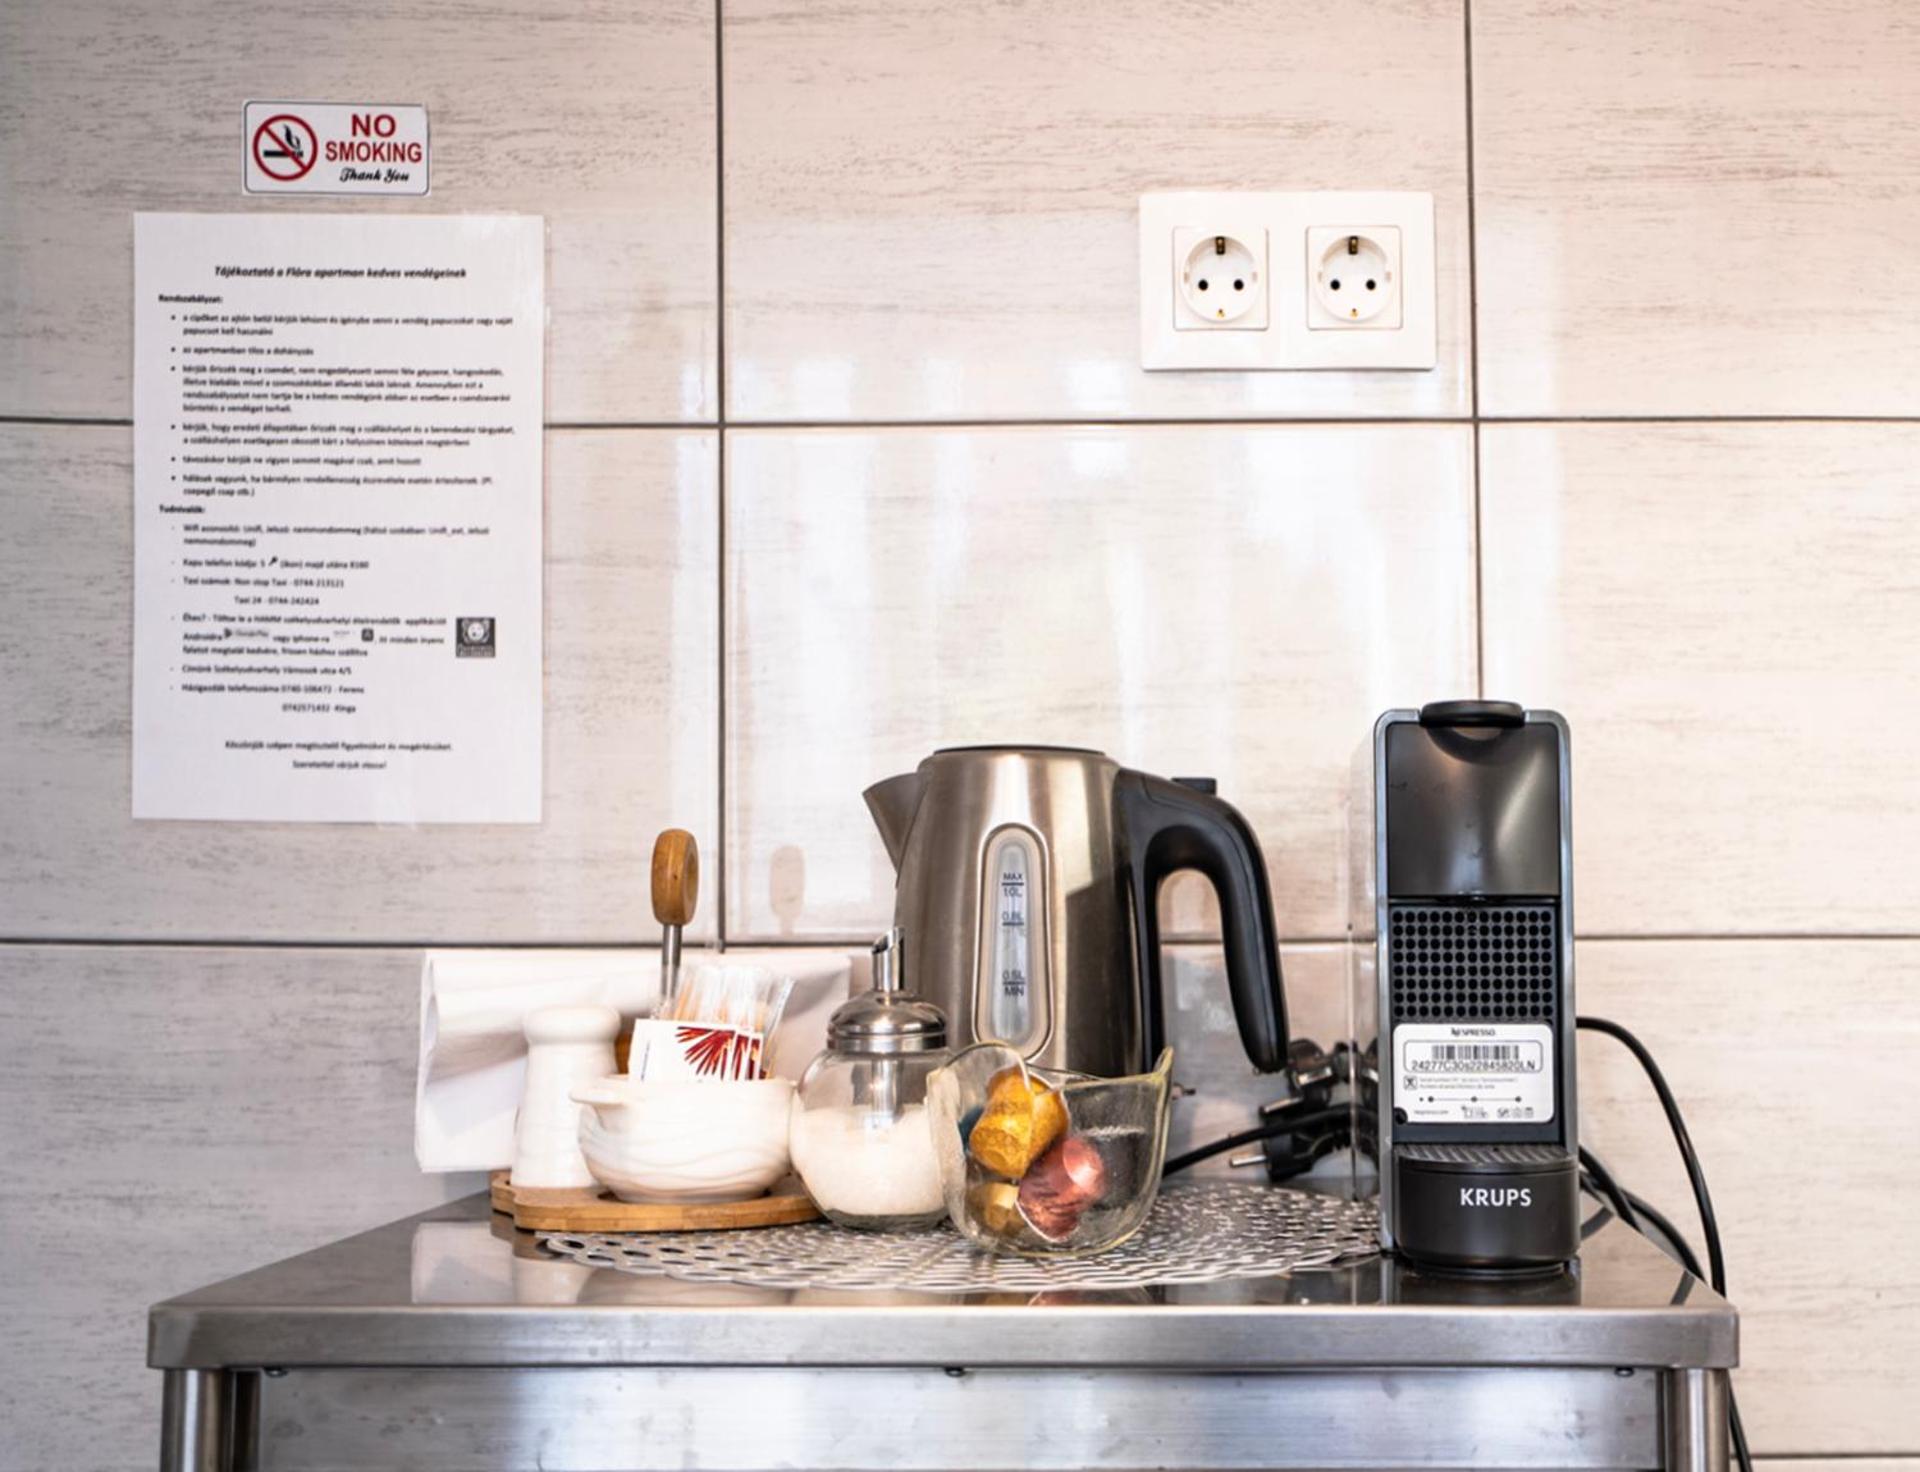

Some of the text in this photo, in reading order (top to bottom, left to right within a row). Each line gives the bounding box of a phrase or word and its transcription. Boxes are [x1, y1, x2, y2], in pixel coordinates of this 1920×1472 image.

[351, 114, 396, 137] NO
[325, 141, 422, 163] SMOKING
[339, 167, 410, 183] Thank You
[314, 269, 364, 278] apartman
[1461, 1188, 1532, 1206] KRUPS
